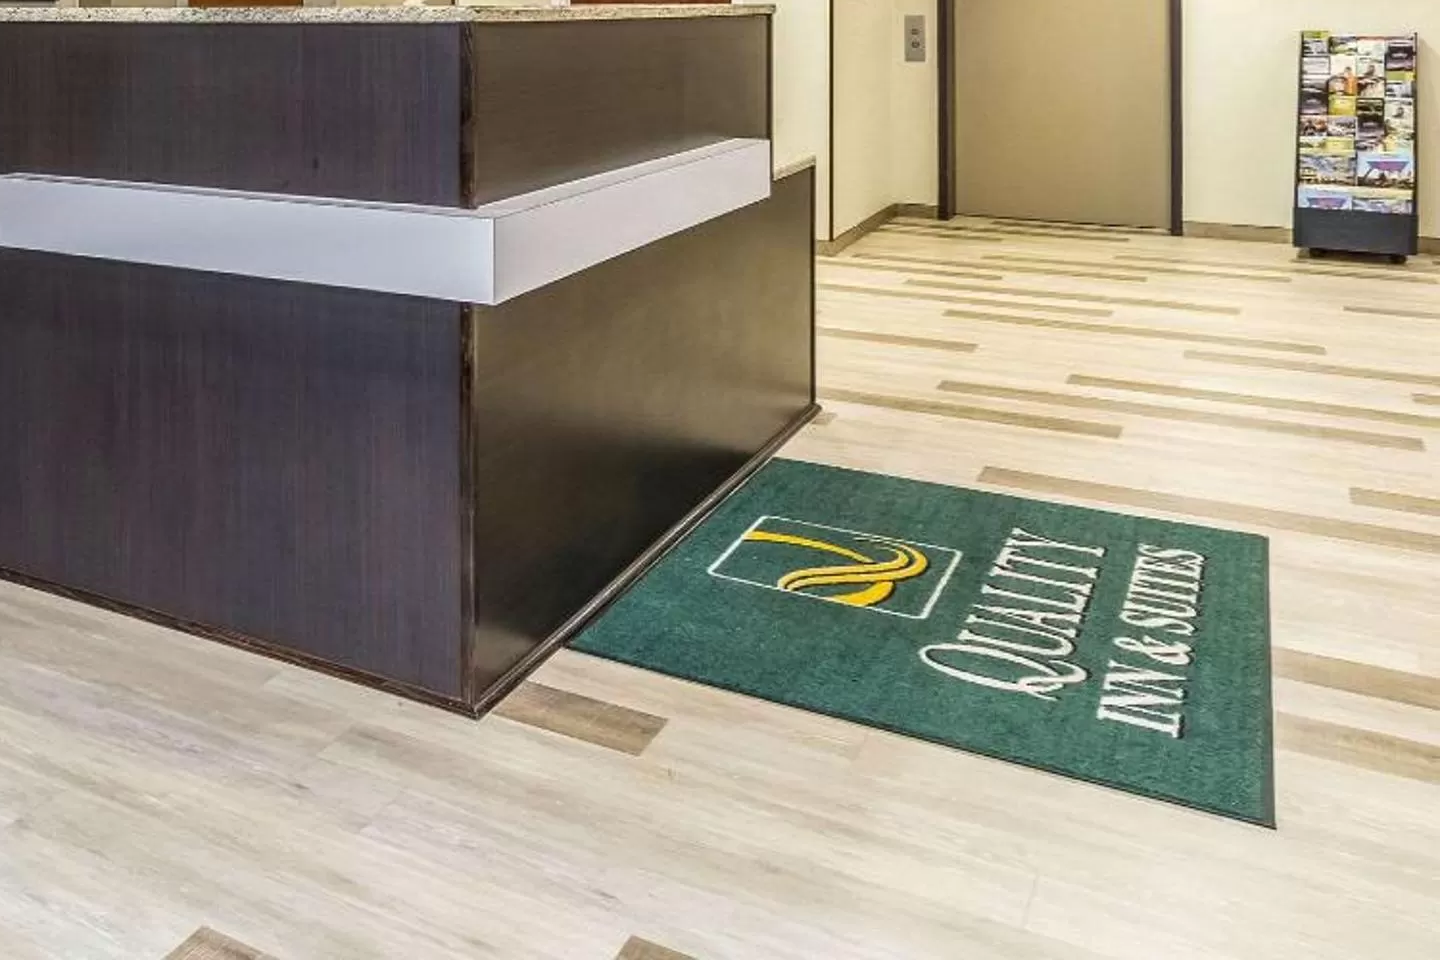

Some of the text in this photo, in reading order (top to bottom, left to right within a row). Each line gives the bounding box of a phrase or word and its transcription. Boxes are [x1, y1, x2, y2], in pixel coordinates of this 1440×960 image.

[917, 527, 1106, 702] QUALITY
[1096, 542, 1206, 739] INN & SUITES
